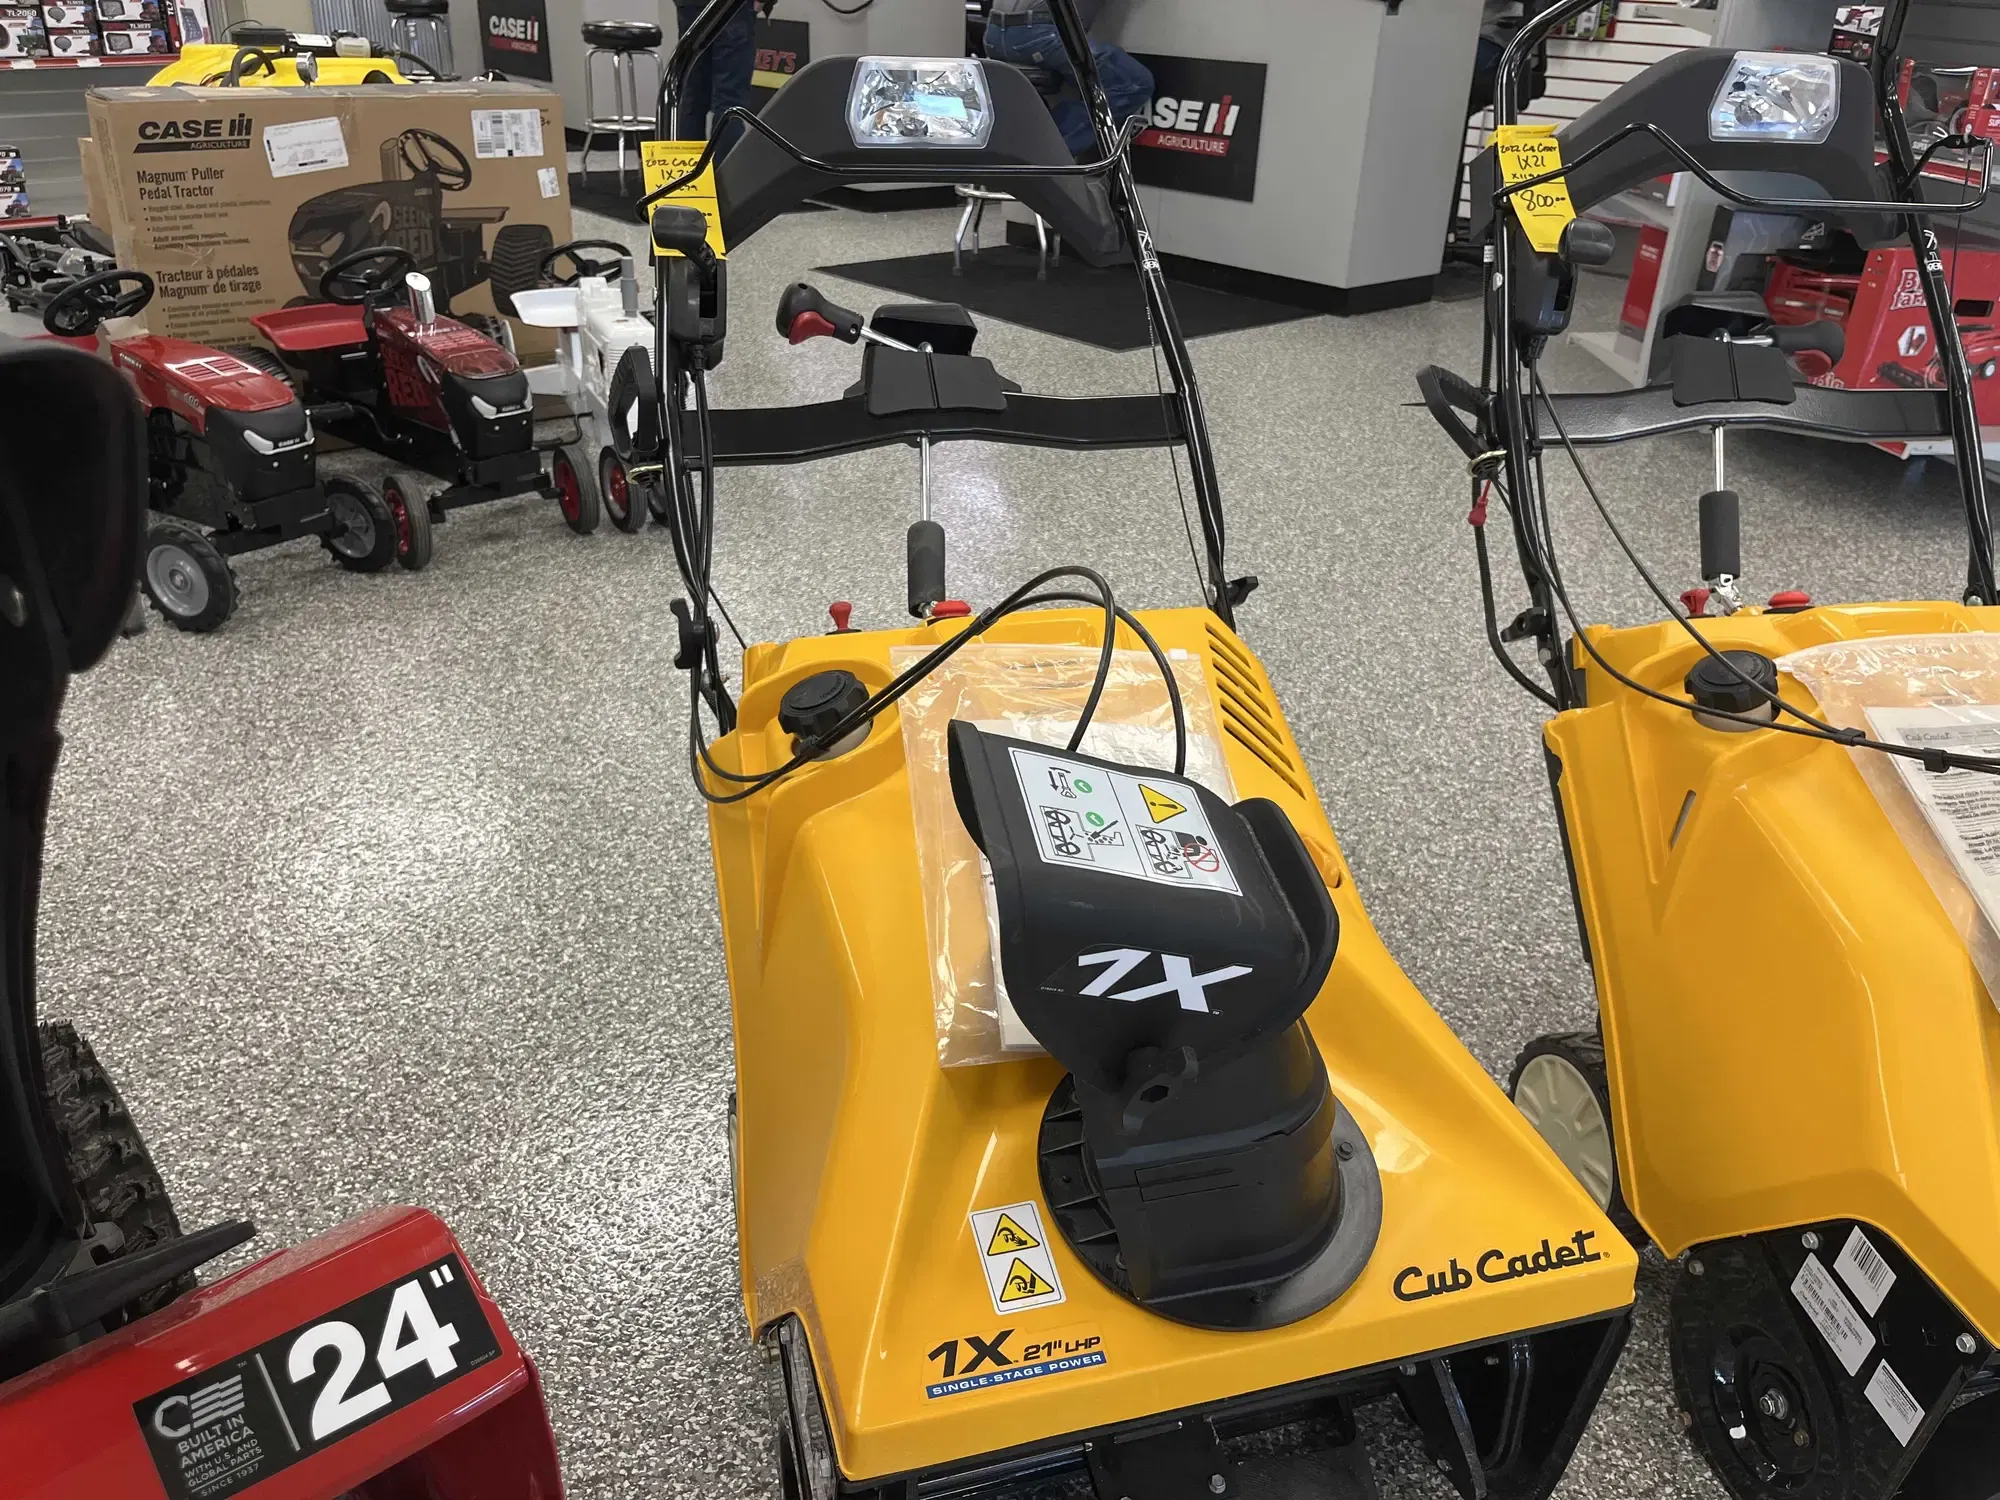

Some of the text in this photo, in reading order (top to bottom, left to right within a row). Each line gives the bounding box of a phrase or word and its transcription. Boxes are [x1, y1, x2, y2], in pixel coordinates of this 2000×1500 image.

[7, 9, 37, 17] TL2060
[489, 15, 525, 39] CASE
[138, 120, 223, 140] CASE
[190, 140, 249, 150] AGRICULTURE
[1157, 134, 1225, 153] AGRICULTURE
[1500, 144, 1521, 154] 2022
[1517, 154, 1546, 170] 1X21
[136, 167, 225, 185] Magnum Puller
[140, 185, 215, 200] Pedal Tractor
[156, 264, 260, 284] Tracteur à pédales
[159, 280, 263, 300] Magnum de tirage
[1078, 948, 1253, 1013] 1X
[1393, 1229, 1601, 1301] Cub Cadet
[289, 1263, 460, 1440] 24"
[927, 1328, 1101, 1378] 1X 21" LHP
[932, 1354, 1102, 1396] SINGLE-STAGE POWER
[177, 1413, 245, 1454] BUILT IN
[180, 1425, 255, 1469] AMERICA
[184, 1438, 259, 1479] WITH U.S. AND
[187, 1446, 262, 1488] GLOBAL PARTS
[201, 1462, 260, 1498] SINCE 1937
